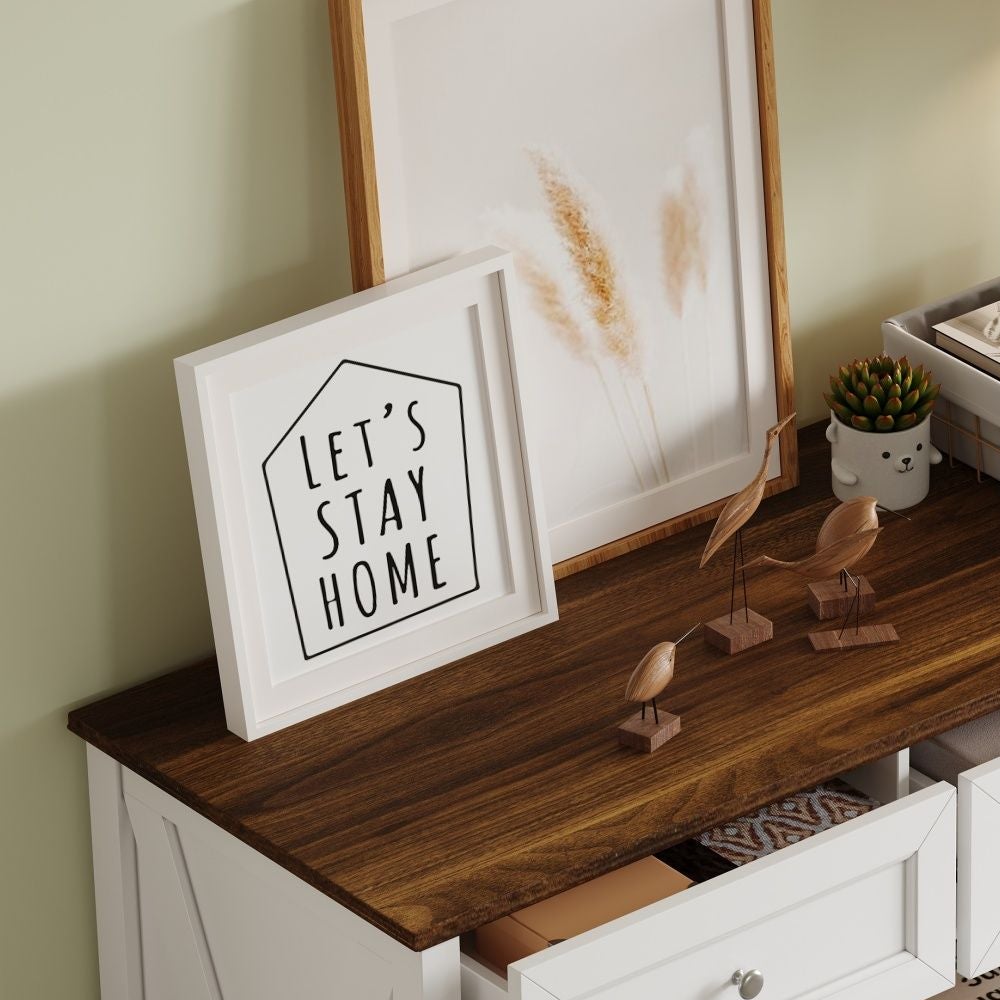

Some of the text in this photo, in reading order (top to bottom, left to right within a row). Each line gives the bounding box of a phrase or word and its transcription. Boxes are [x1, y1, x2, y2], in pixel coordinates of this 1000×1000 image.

[300, 400, 426, 490] LET'S
[317, 466, 426, 560] STAY
[319, 533, 447, 630] HOME
